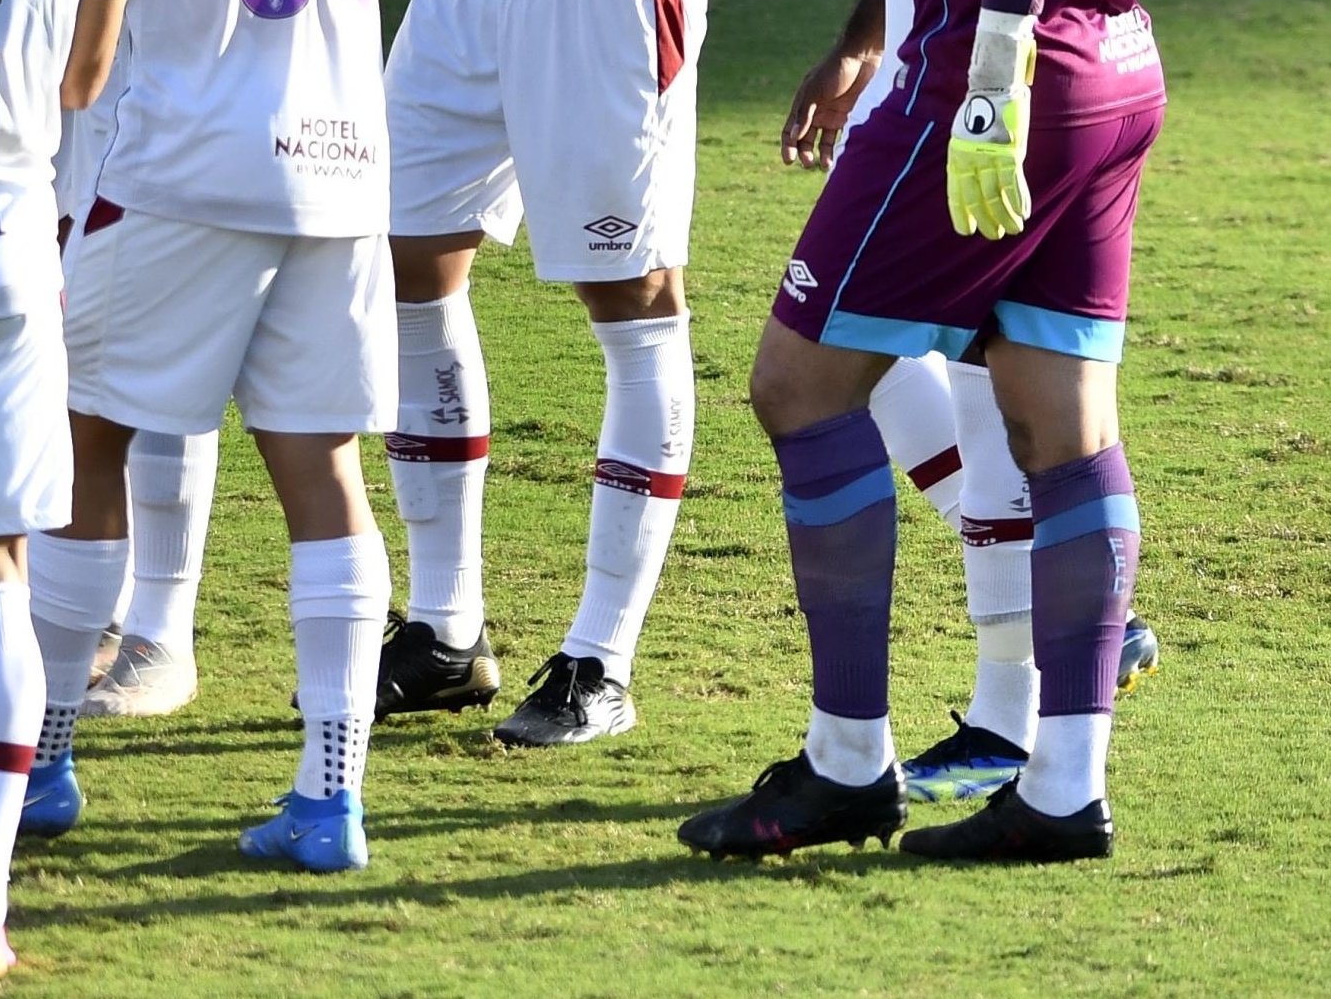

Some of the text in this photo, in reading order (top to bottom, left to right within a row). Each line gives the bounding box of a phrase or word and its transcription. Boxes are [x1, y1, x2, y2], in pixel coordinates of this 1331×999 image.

[301, 117, 358, 140] HOTEL
[275, 136, 376, 164] NACIONAL
[314, 164, 362, 179] WAM
[588, 241, 633, 251] umbro
